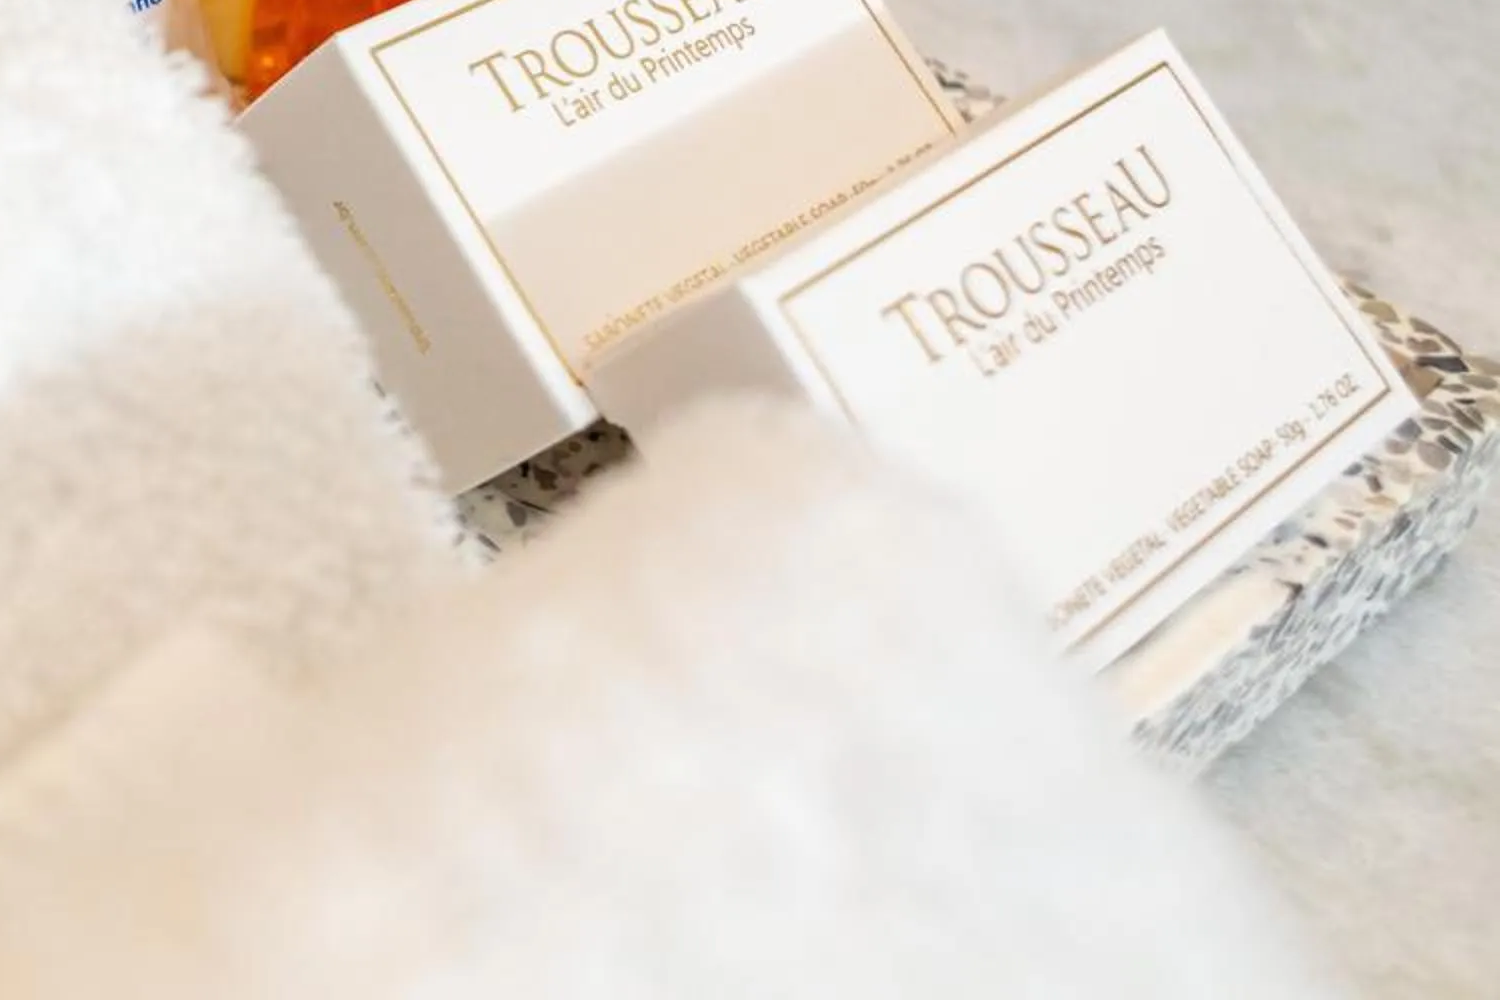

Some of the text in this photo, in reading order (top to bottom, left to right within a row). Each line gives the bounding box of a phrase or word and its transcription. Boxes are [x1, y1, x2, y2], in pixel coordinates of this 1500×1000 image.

[552, 16, 756, 127] L'air du Printemps
[879, 144, 1172, 364] TROUSSEAU
[1023, 309, 1058, 344] du
[1051, 236, 1166, 320] Printemps
[1166, 465, 1241, 533] VEGETABLE
[1236, 438, 1273, 478] SOAP
[1334, 372, 1361, 399] OZ
